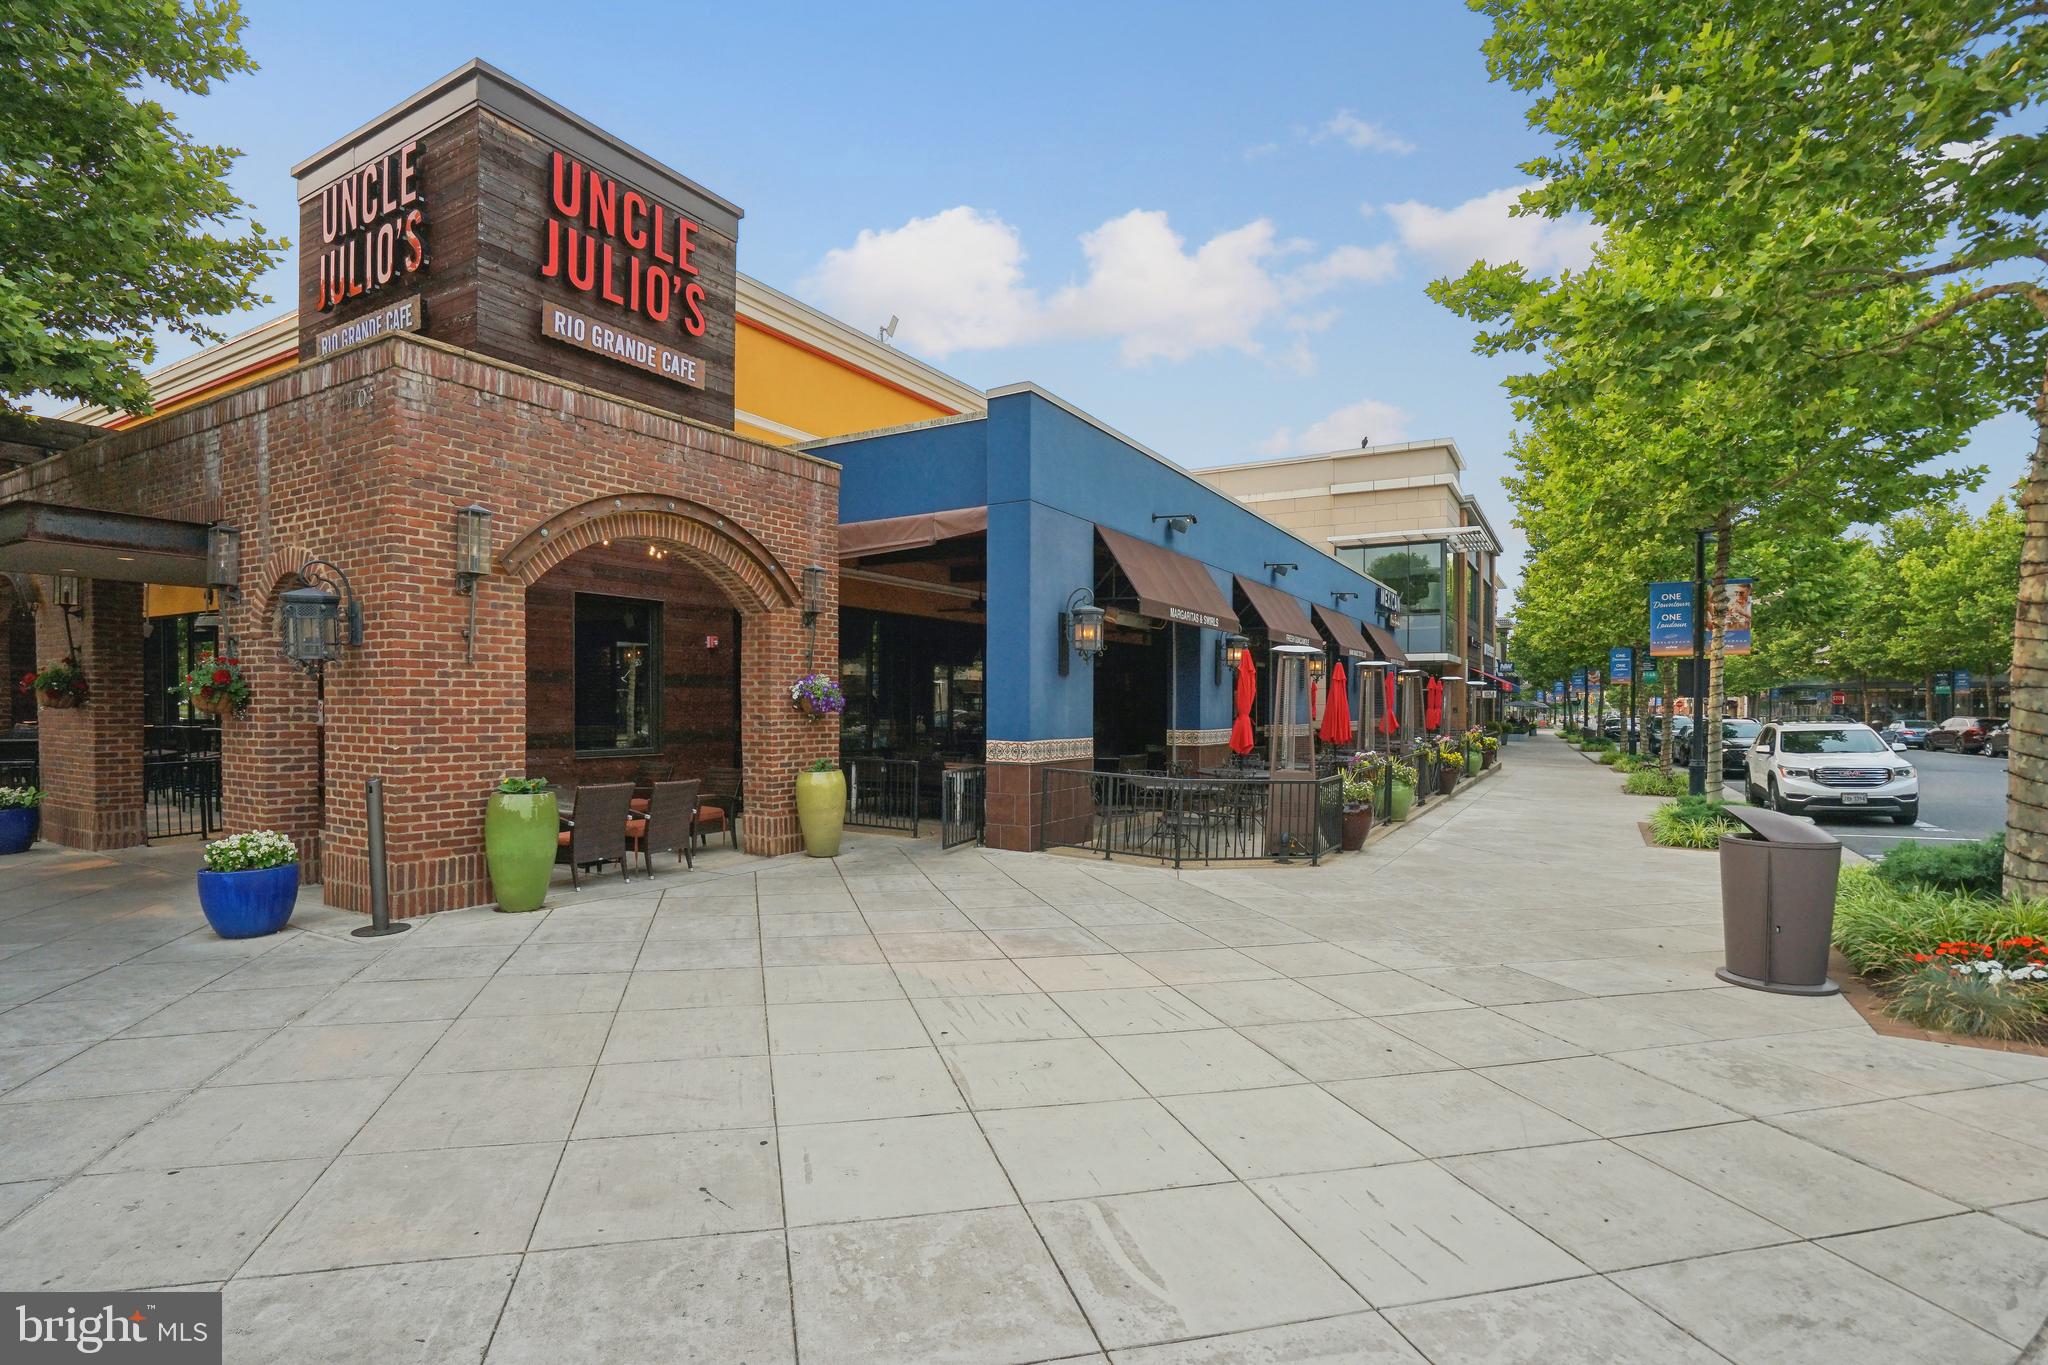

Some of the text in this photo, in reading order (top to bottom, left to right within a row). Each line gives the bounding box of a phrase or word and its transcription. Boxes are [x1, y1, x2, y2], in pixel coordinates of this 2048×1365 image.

[322, 141, 417, 244] UNCLE
[552, 150, 699, 277] UNCLE
[316, 208, 423, 313] JULIO'S
[542, 217, 707, 338] JULIO'S
[385, 302, 413, 331] CAFE
[553, 310, 697, 383] RIO GRANDE CAFE
[1652, 601, 1691, 609] Downtown
[1661, 592, 1682, 601] ONE
[1169, 607, 1199, 623] MARGARITAS
[1656, 621, 1688, 629] Loudoun
[1661, 613, 1682, 621] ONE
